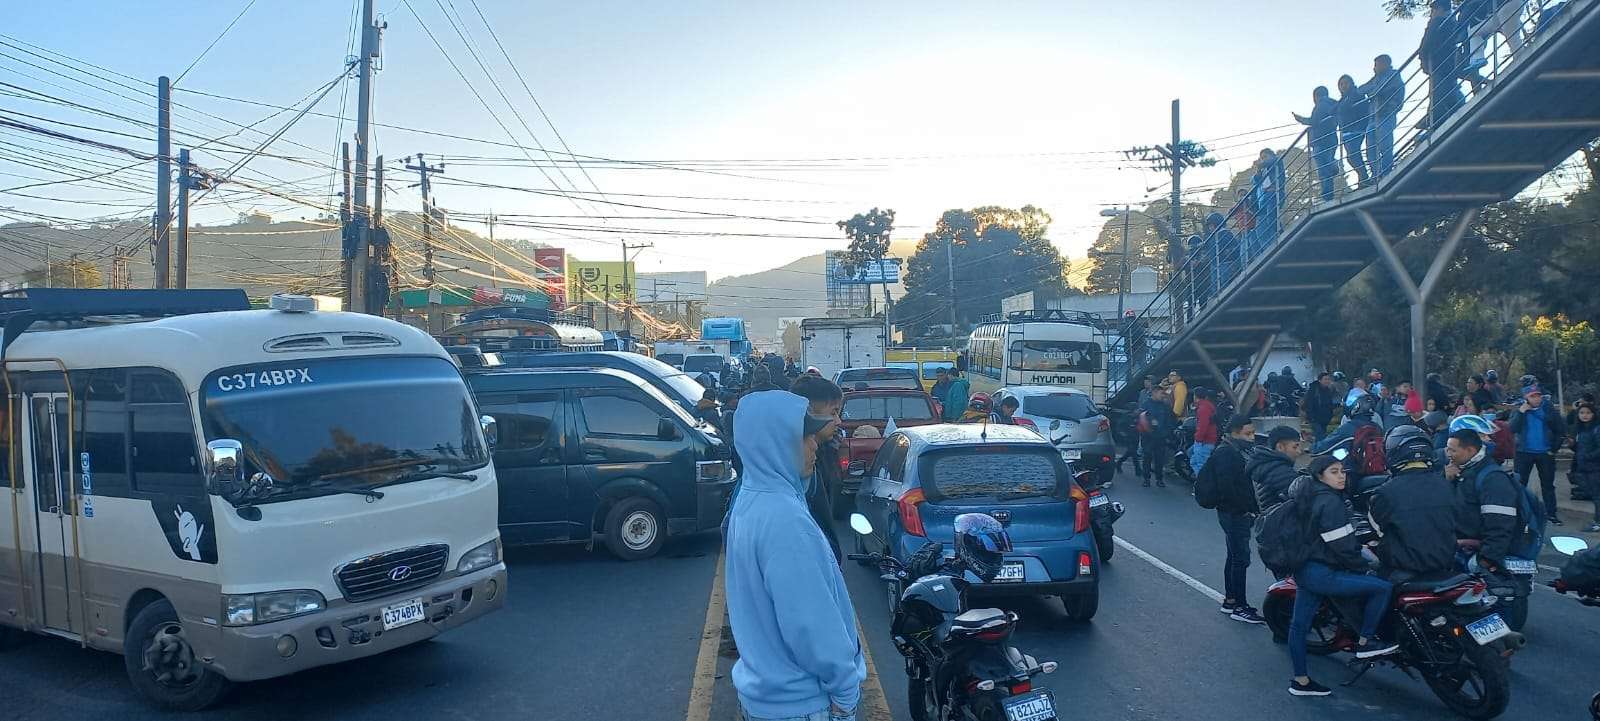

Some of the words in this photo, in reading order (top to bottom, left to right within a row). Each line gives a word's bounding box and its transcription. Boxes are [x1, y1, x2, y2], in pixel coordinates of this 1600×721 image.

[504, 293, 526, 303] PUMA
[218, 368, 313, 391] C374BPX
[1032, 375, 1076, 384] HYUNDAI
[1001, 566, 1023, 577] 7GFH
[384, 603, 423, 625] C374BPX
